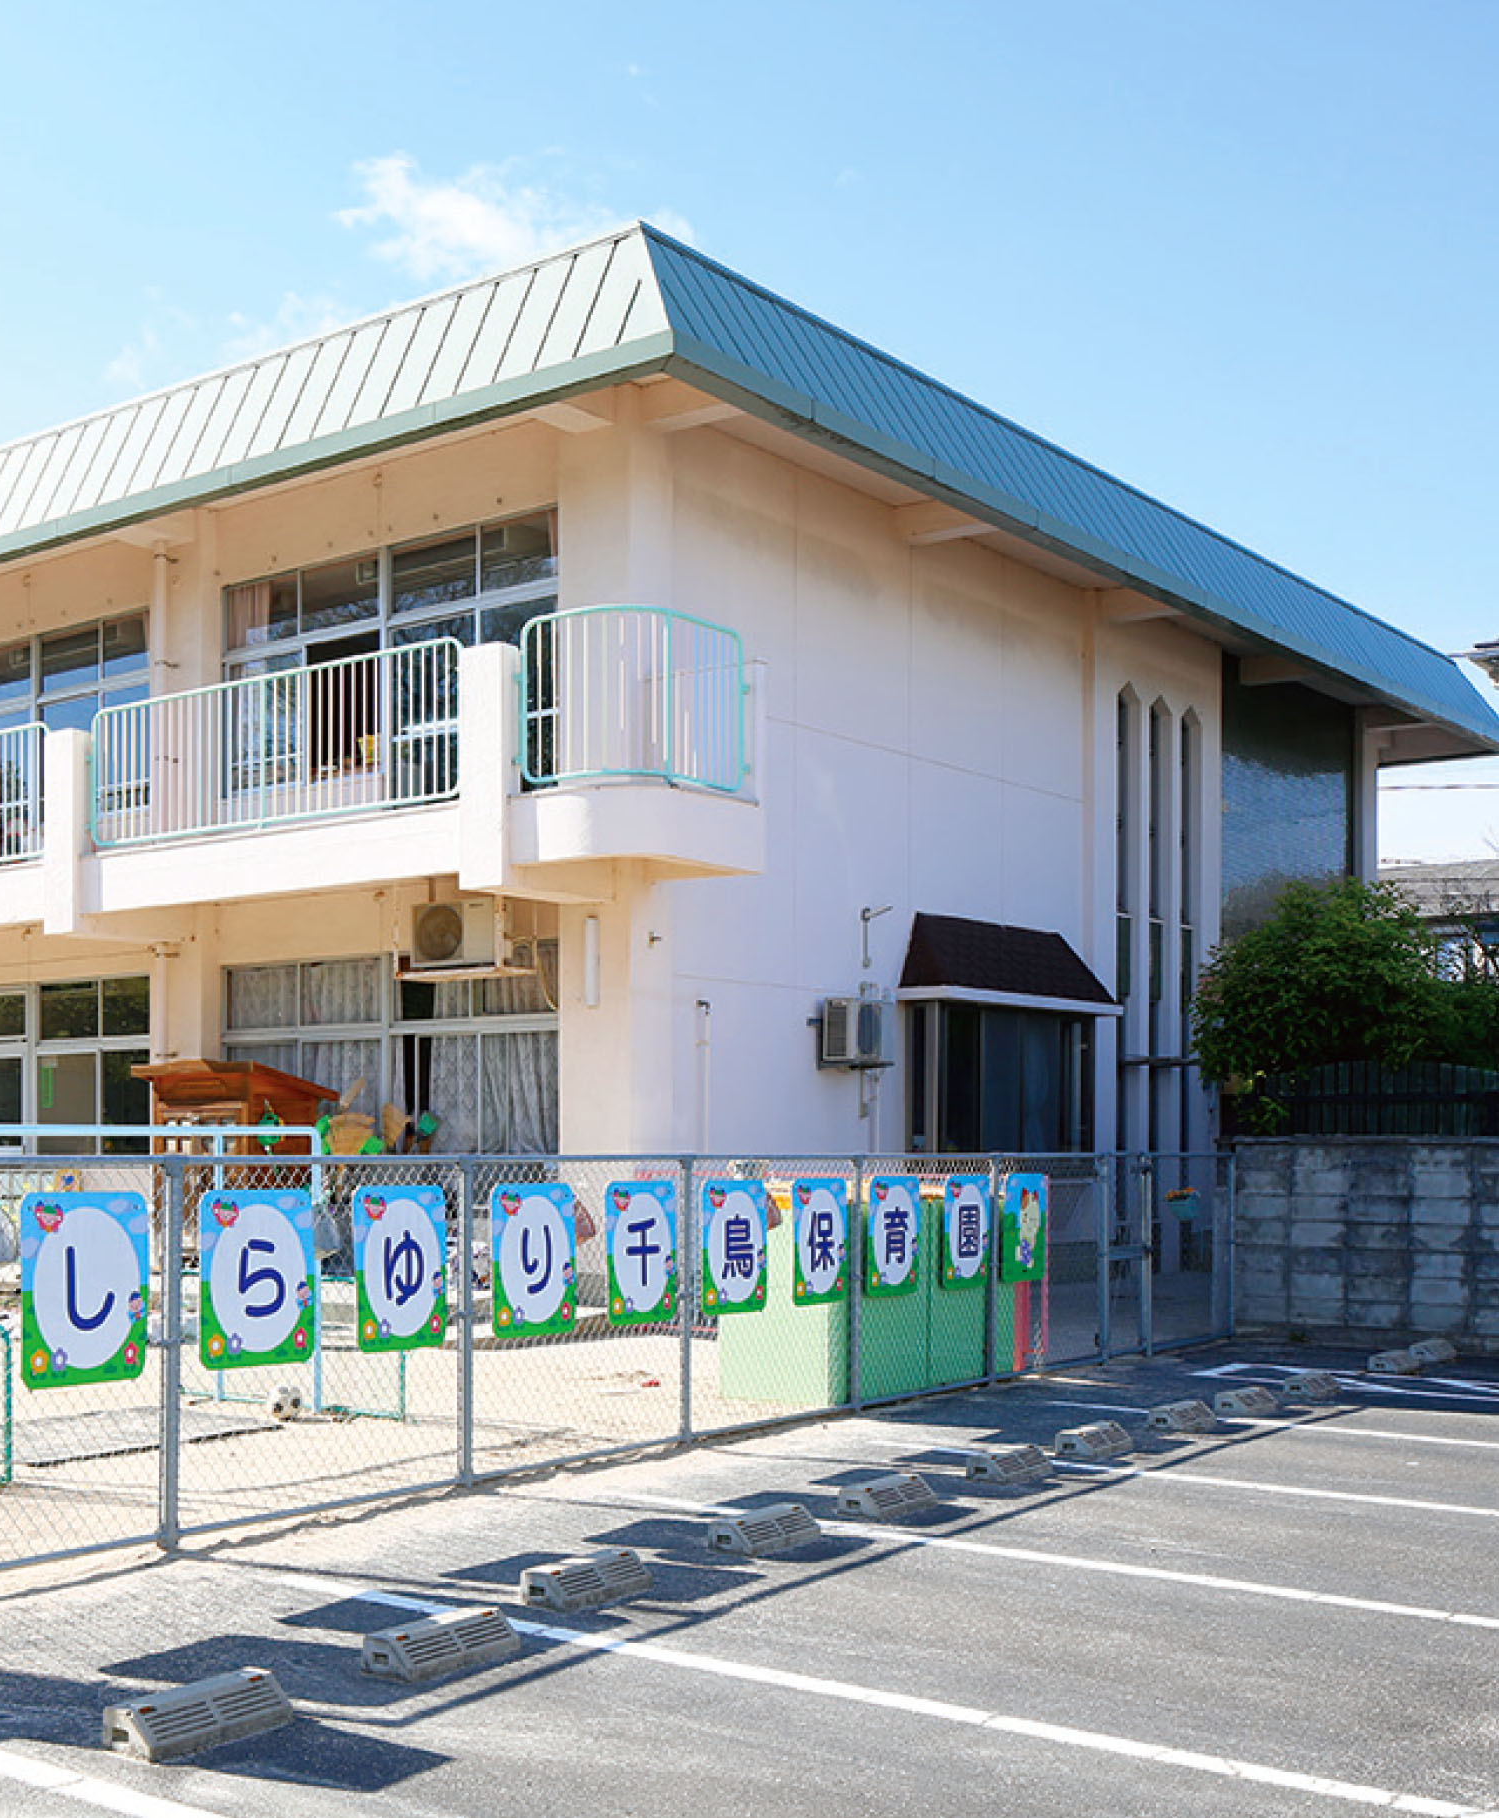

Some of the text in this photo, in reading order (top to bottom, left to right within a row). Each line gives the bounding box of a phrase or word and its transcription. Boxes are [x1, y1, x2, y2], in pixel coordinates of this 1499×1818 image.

[65, 1205, 981, 1331] しらゆり千鳥保育園
